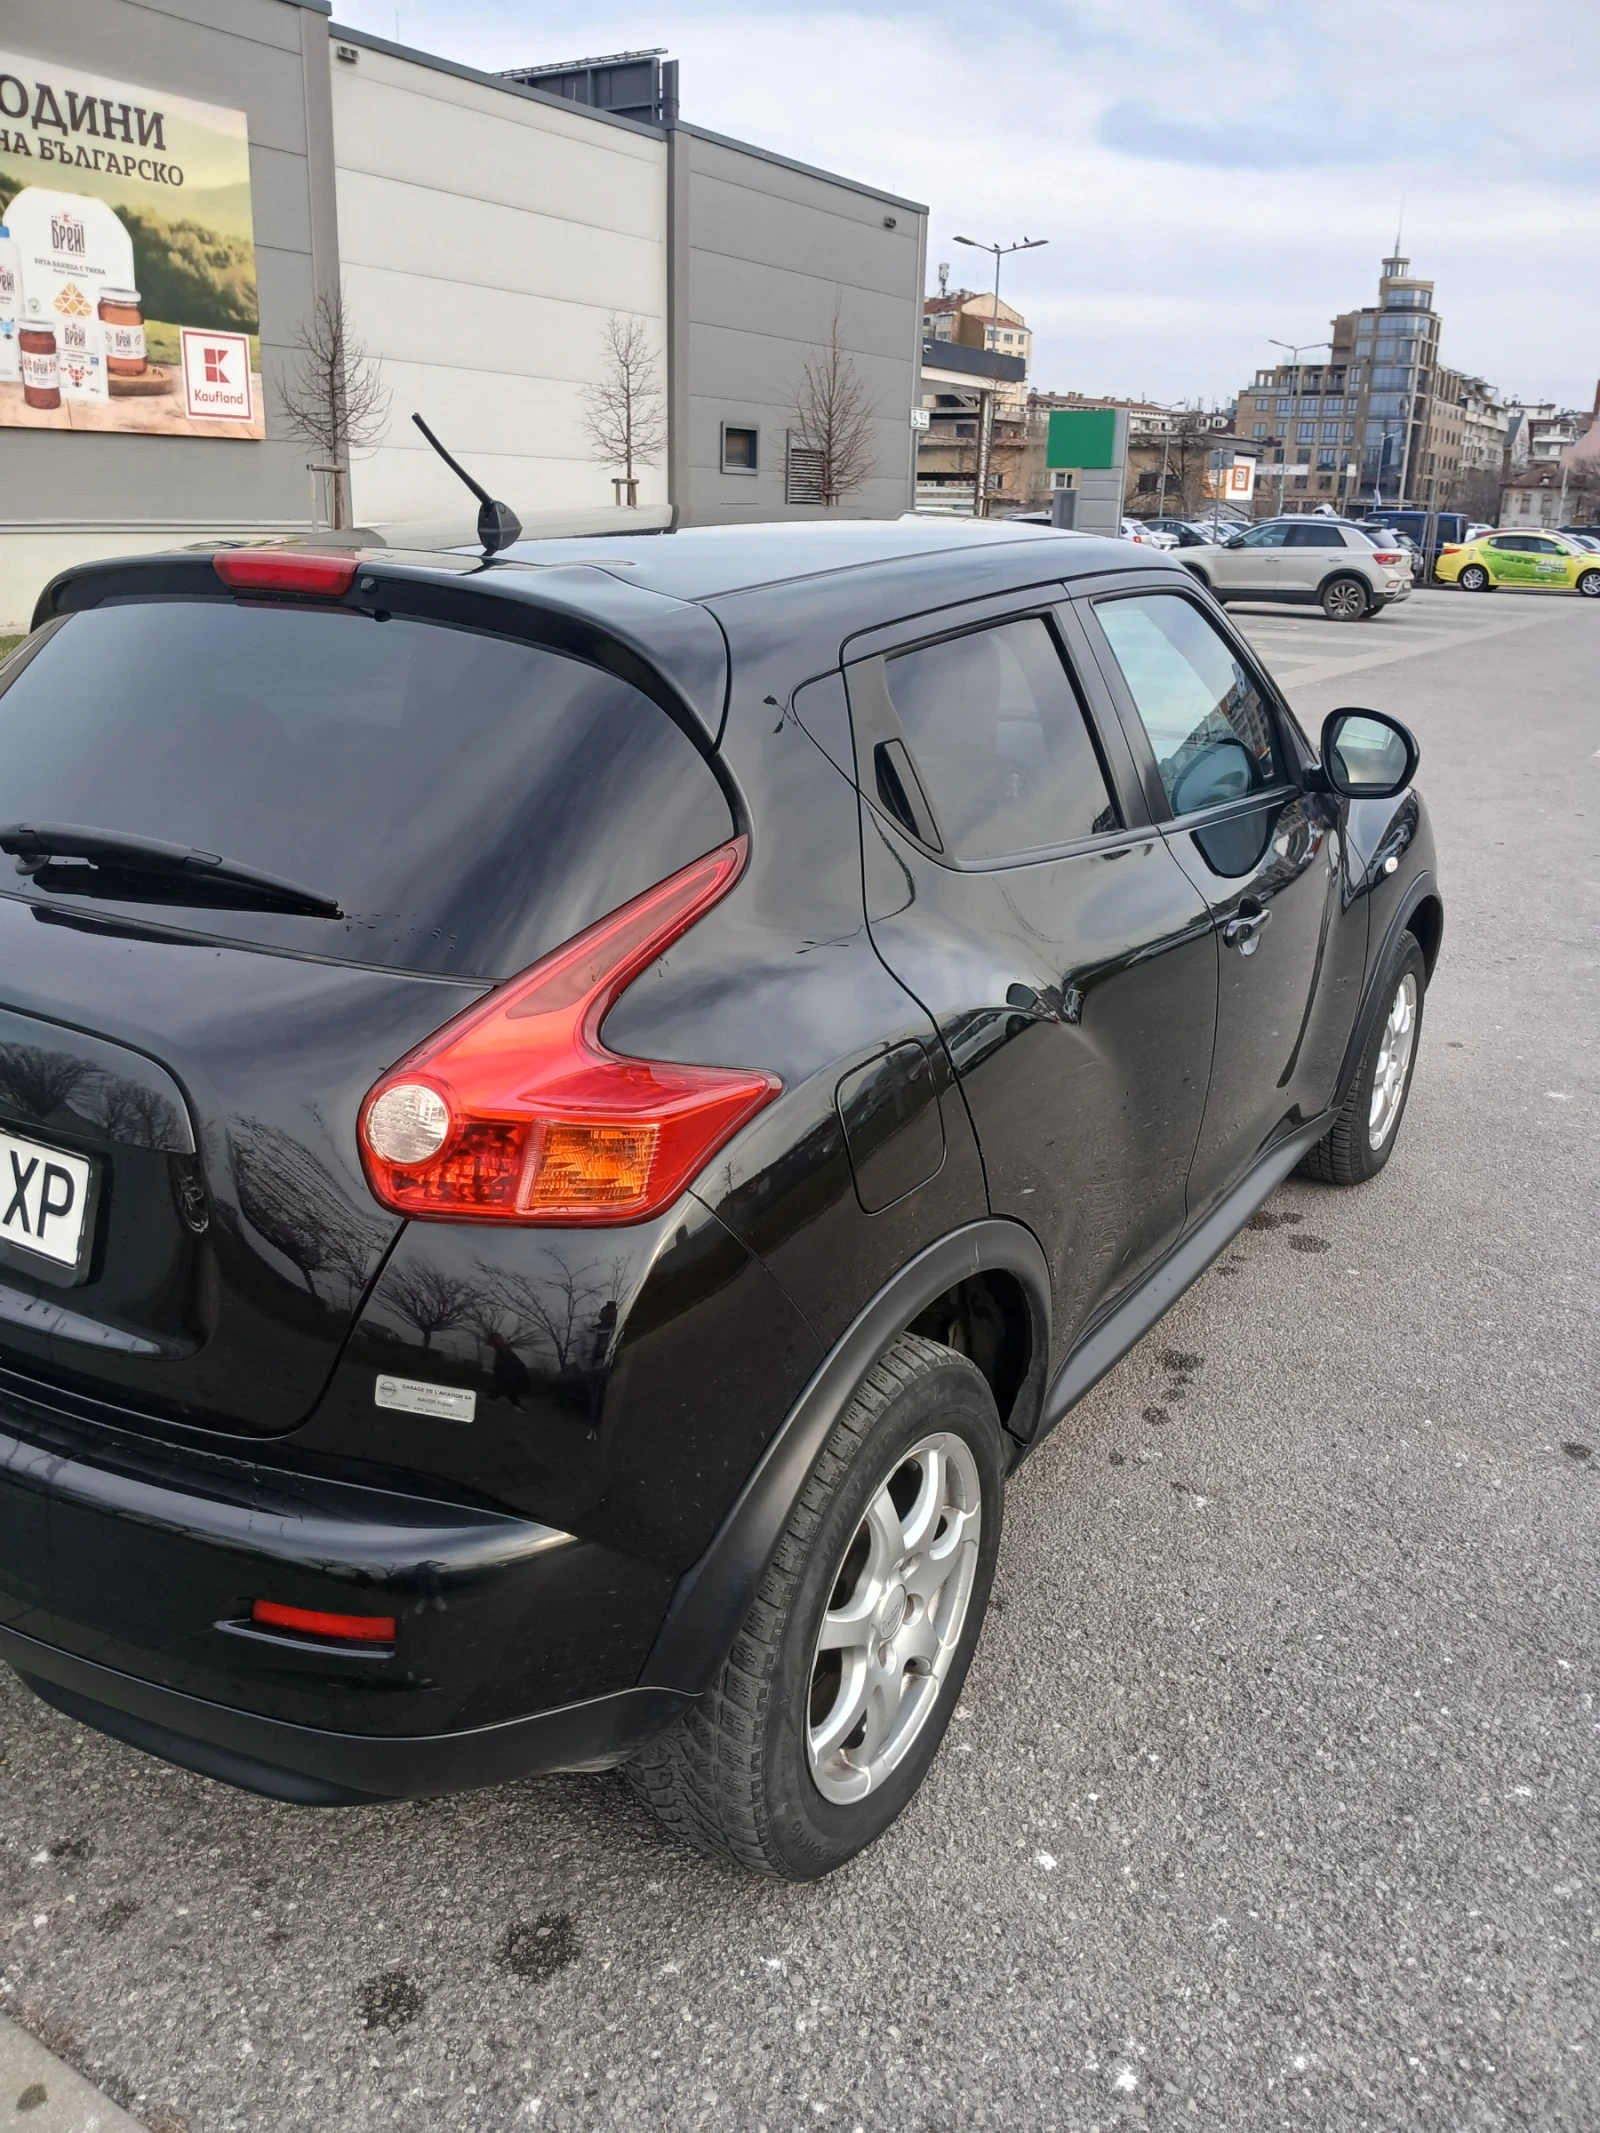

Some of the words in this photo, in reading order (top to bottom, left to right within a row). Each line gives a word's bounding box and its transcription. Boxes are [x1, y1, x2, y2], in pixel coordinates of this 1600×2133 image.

[38, 137, 184, 186] БЪЛГАРСКО
[194, 388, 244, 405] Kaufland
[2, 1149, 75, 1239] XP
[402, 1384, 425, 1392] GARAGE
[434, 1389, 464, 1400] L'AVIATION
